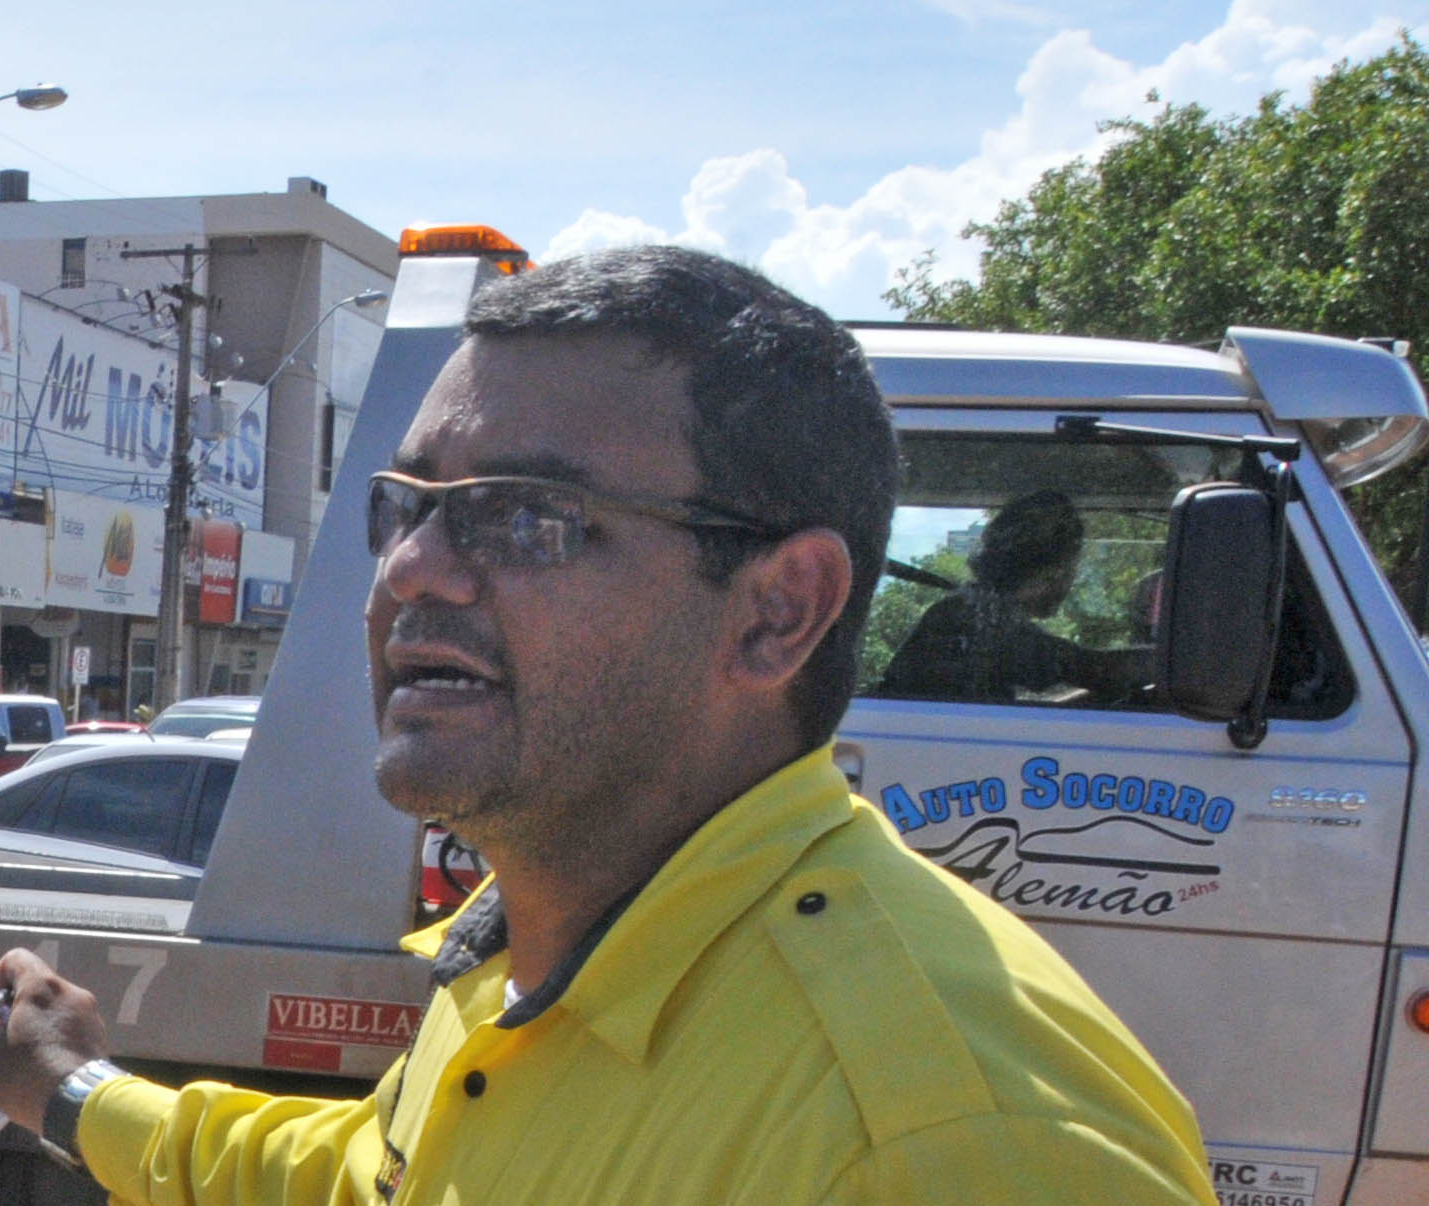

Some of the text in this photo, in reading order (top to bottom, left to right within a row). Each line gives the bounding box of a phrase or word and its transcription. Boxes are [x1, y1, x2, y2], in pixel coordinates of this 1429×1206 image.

[881, 755, 1235, 835] AUTO SOCORRO
[942, 835, 1178, 916] Alemão
[1177, 880, 1219, 903] 24hs
[272, 997, 412, 1036] VIBELLA
